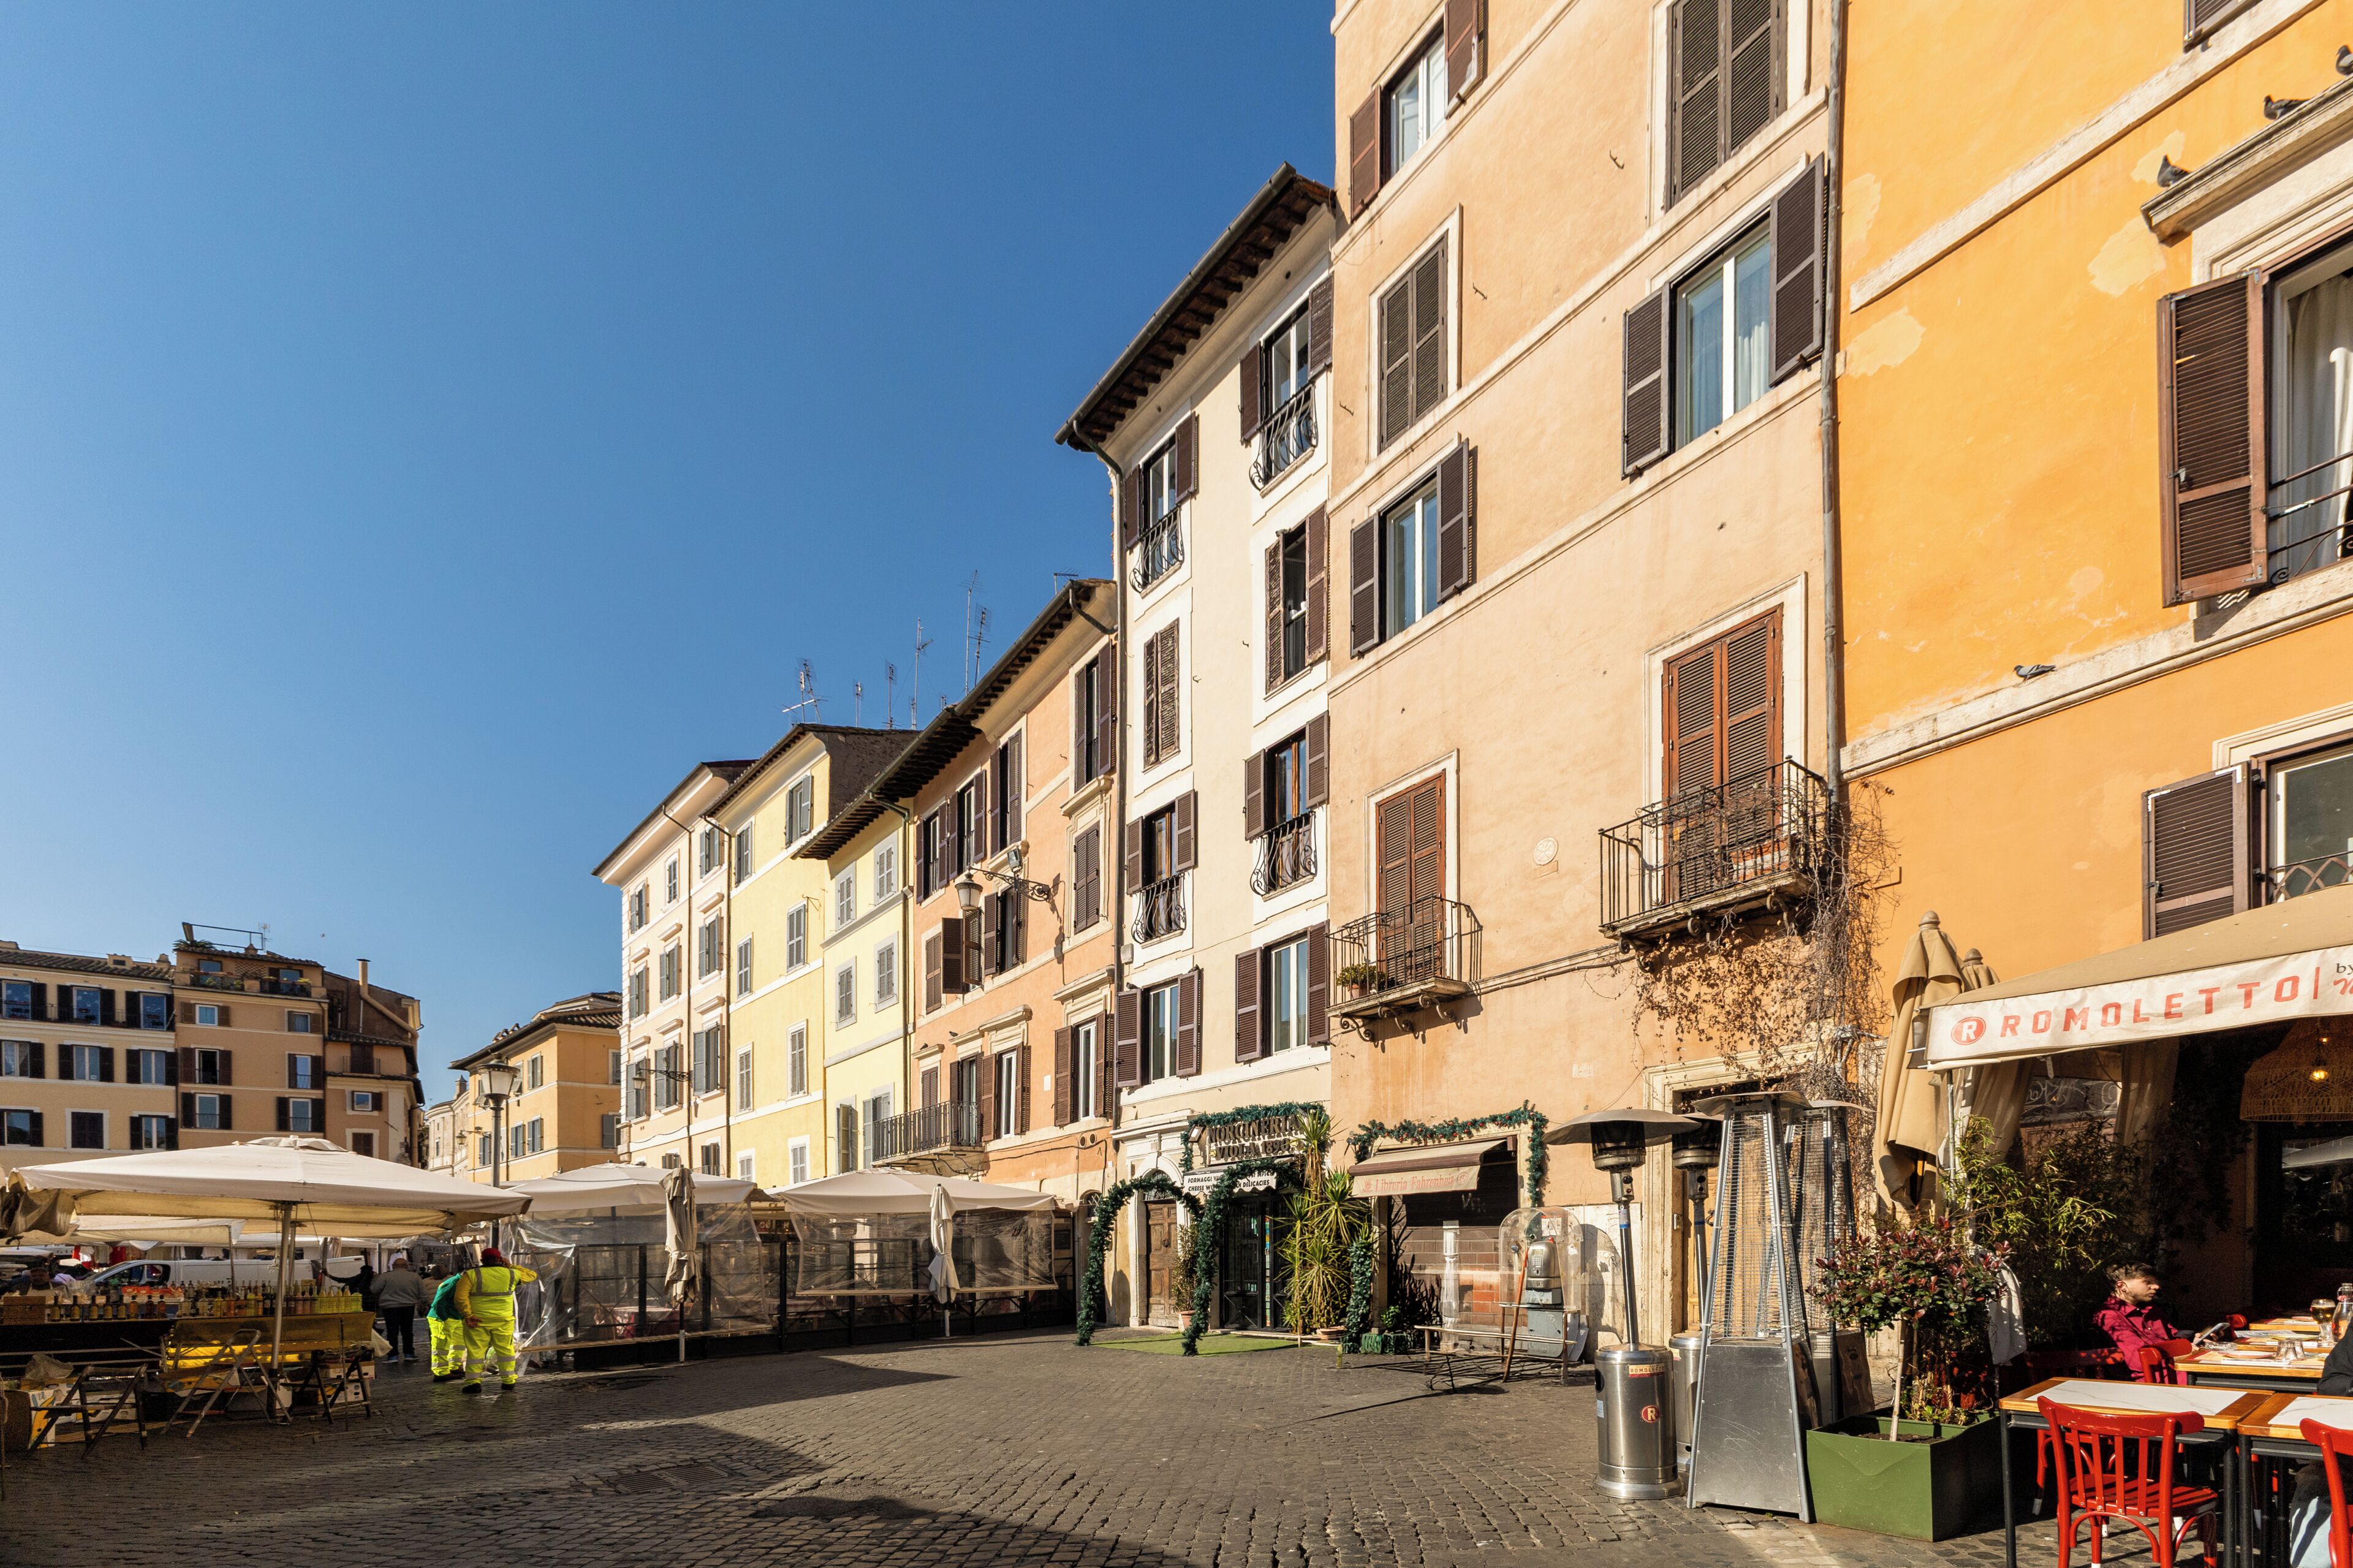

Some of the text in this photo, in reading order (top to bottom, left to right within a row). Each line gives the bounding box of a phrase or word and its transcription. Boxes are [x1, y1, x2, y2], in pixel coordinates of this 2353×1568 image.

[2000, 975, 2300, 1037] ROMOLETTO
[1216, 1138, 1290, 1160] VIOLA 1890
[1374, 1178, 1407, 1192] Libreria
[1411, 1173, 1454, 1190] Fahrenheit
